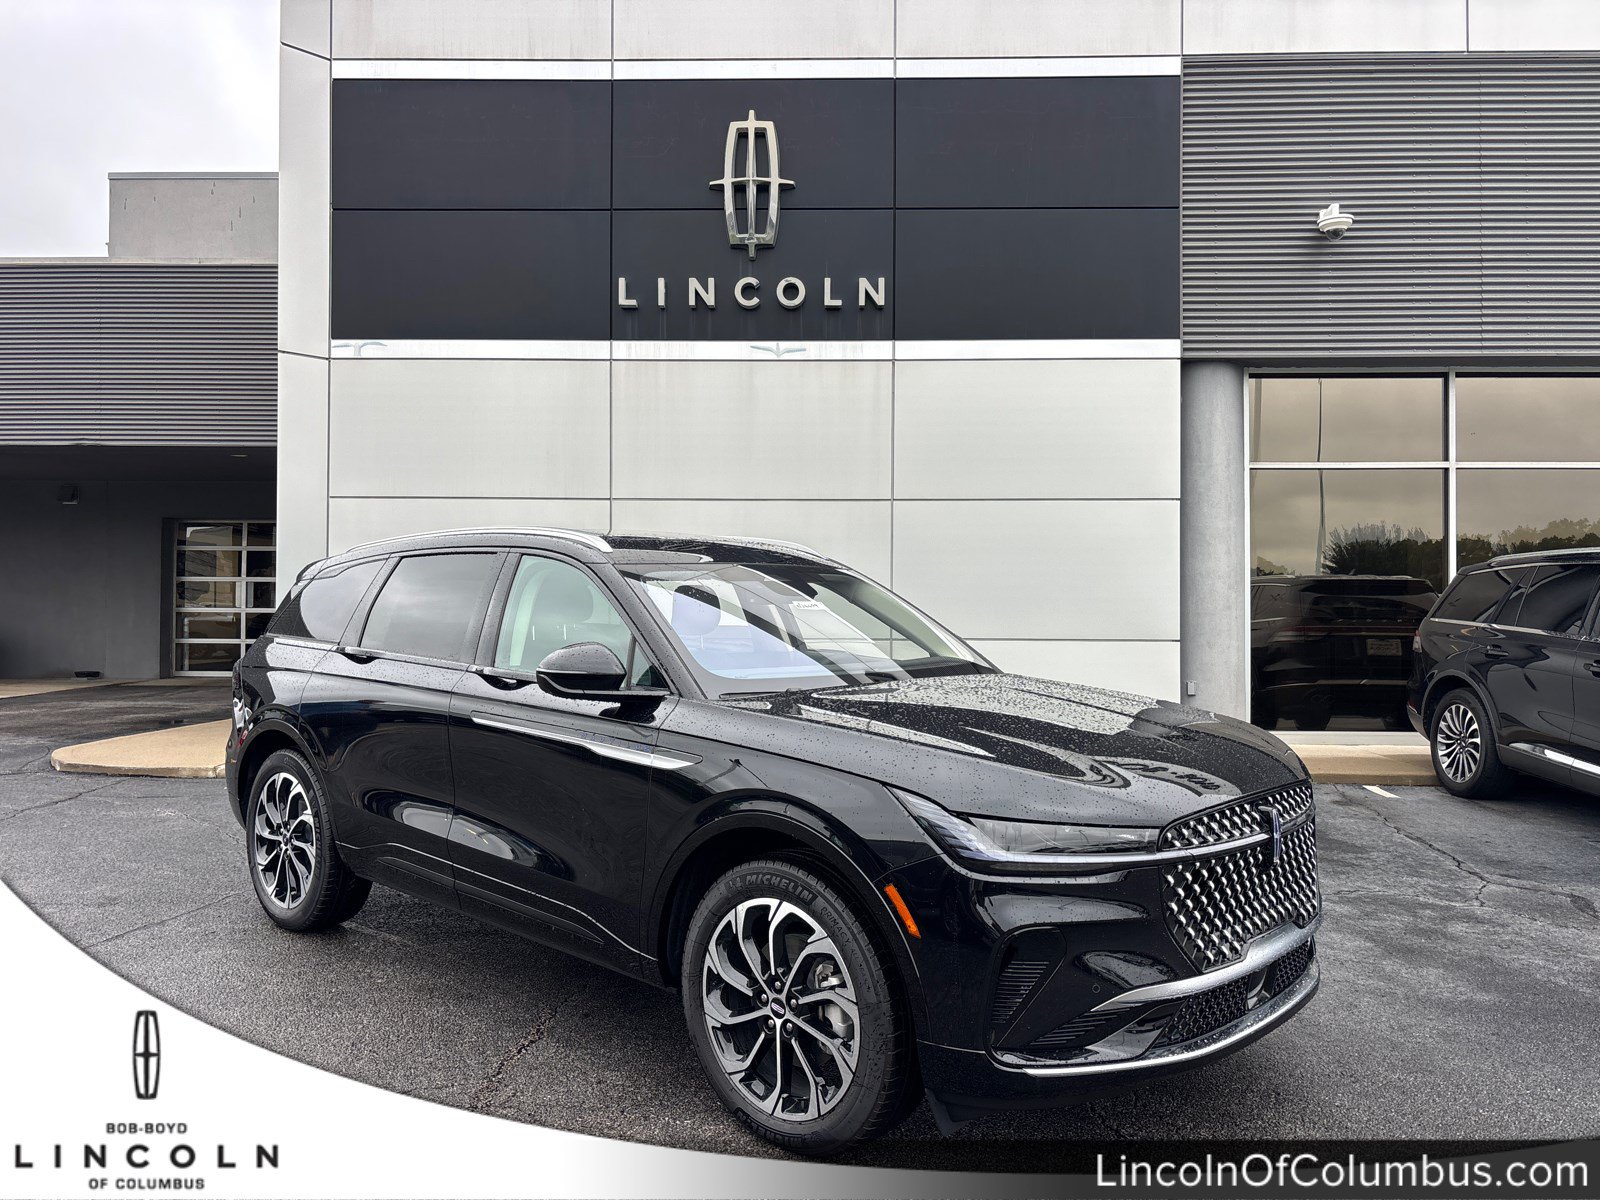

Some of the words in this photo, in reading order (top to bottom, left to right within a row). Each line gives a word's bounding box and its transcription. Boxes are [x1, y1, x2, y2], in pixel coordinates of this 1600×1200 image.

[618, 276, 886, 308] LINCOLN
[745, 874, 813, 902] MICHELIN
[820, 906, 852, 945] PRIMACY
